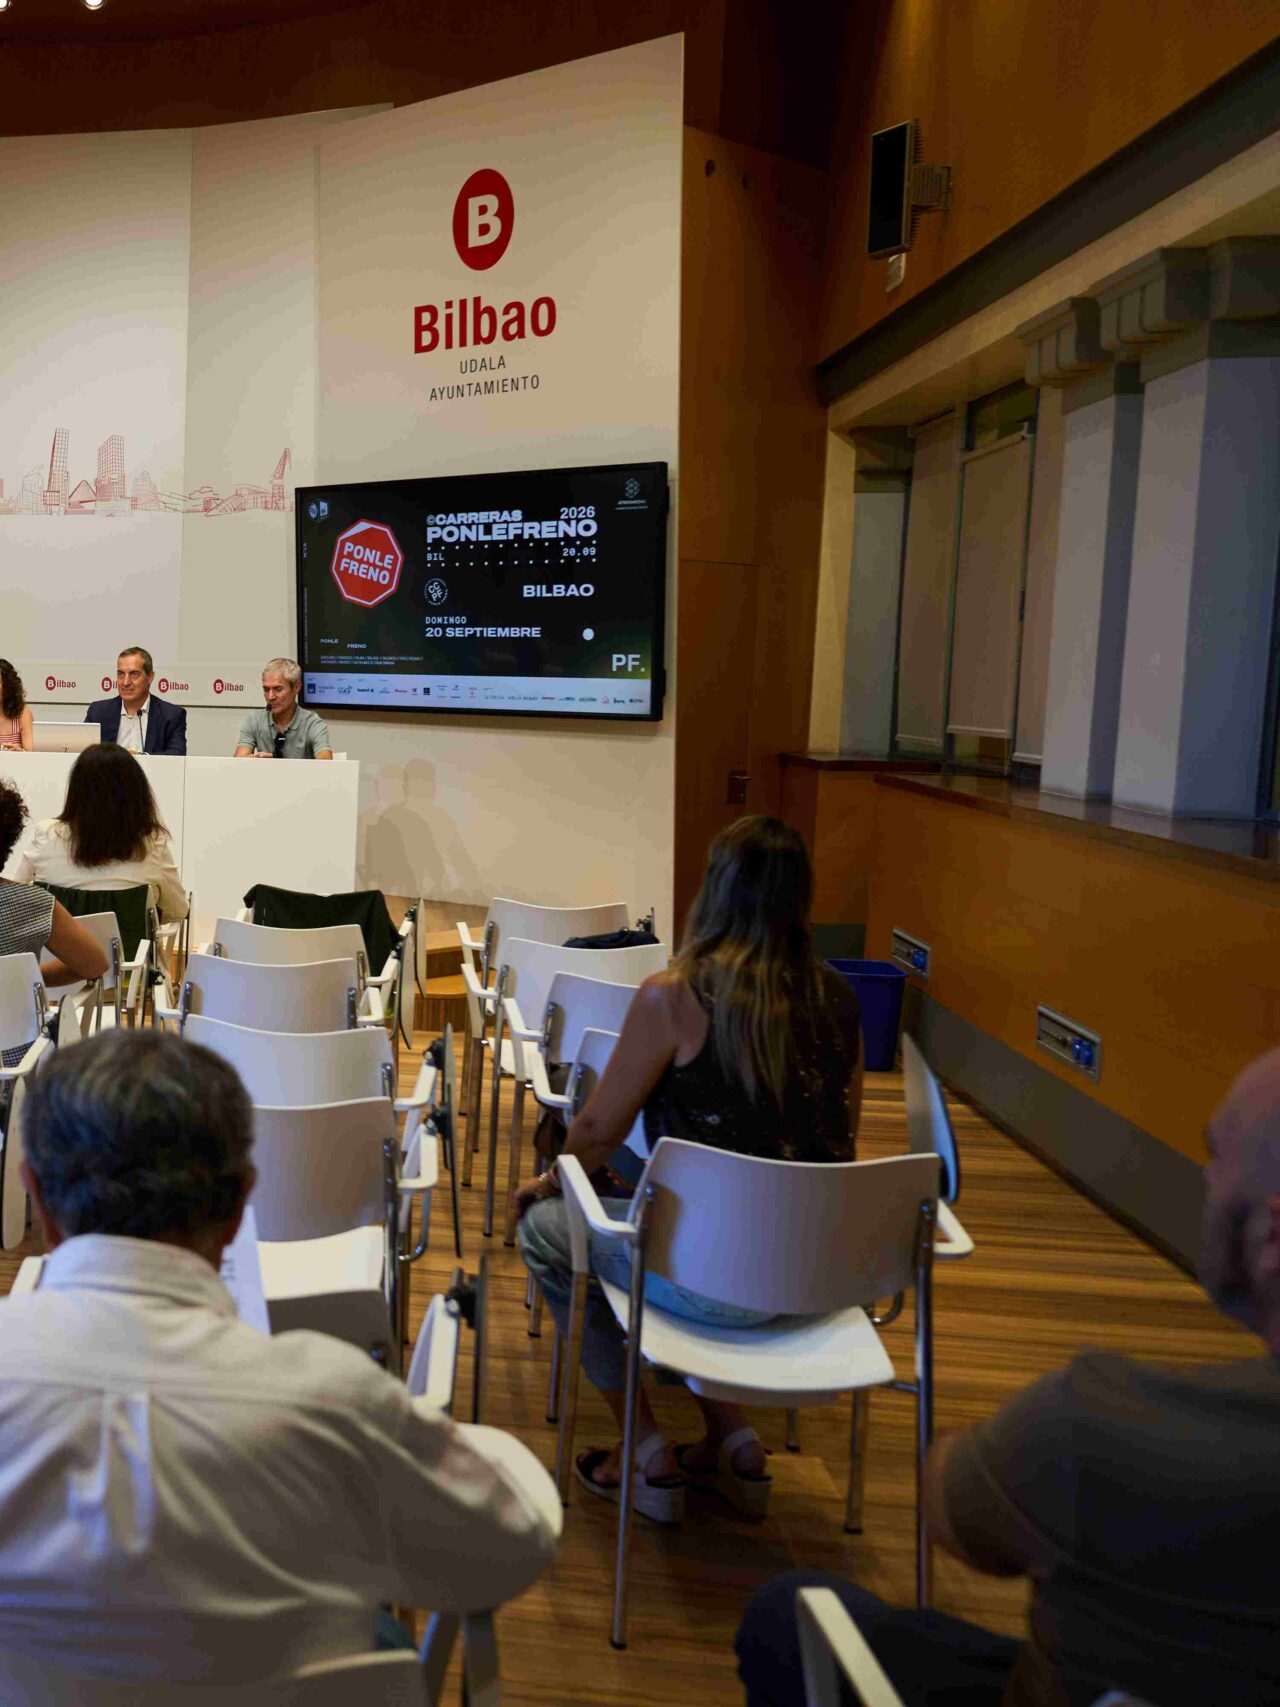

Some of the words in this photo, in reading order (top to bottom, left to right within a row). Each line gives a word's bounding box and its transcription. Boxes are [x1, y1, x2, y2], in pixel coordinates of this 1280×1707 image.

[414, 296, 557, 354] Bilbao
[459, 355, 507, 375] UDALA
[429, 374, 540, 401] AYUNTAMIENTO
[559, 505, 596, 520] 2026
[426, 518, 598, 543] PONLEFRENO
[343, 541, 394, 569] PONLE
[426, 552, 445, 561] BIL
[562, 547, 596, 557] 20.09
[339, 558, 390, 585] FRENO
[522, 583, 595, 598] BILBAO
[425, 615, 468, 625] DOMINGO
[425, 627, 443, 638] 20
[445, 626, 542, 638] SEPTIEMBRE
[611, 654, 646, 672] PF.
[46, 677, 76, 690] Bilbao
[158, 679, 189, 692] Bilbao
[213, 680, 244, 693] Bilbao
